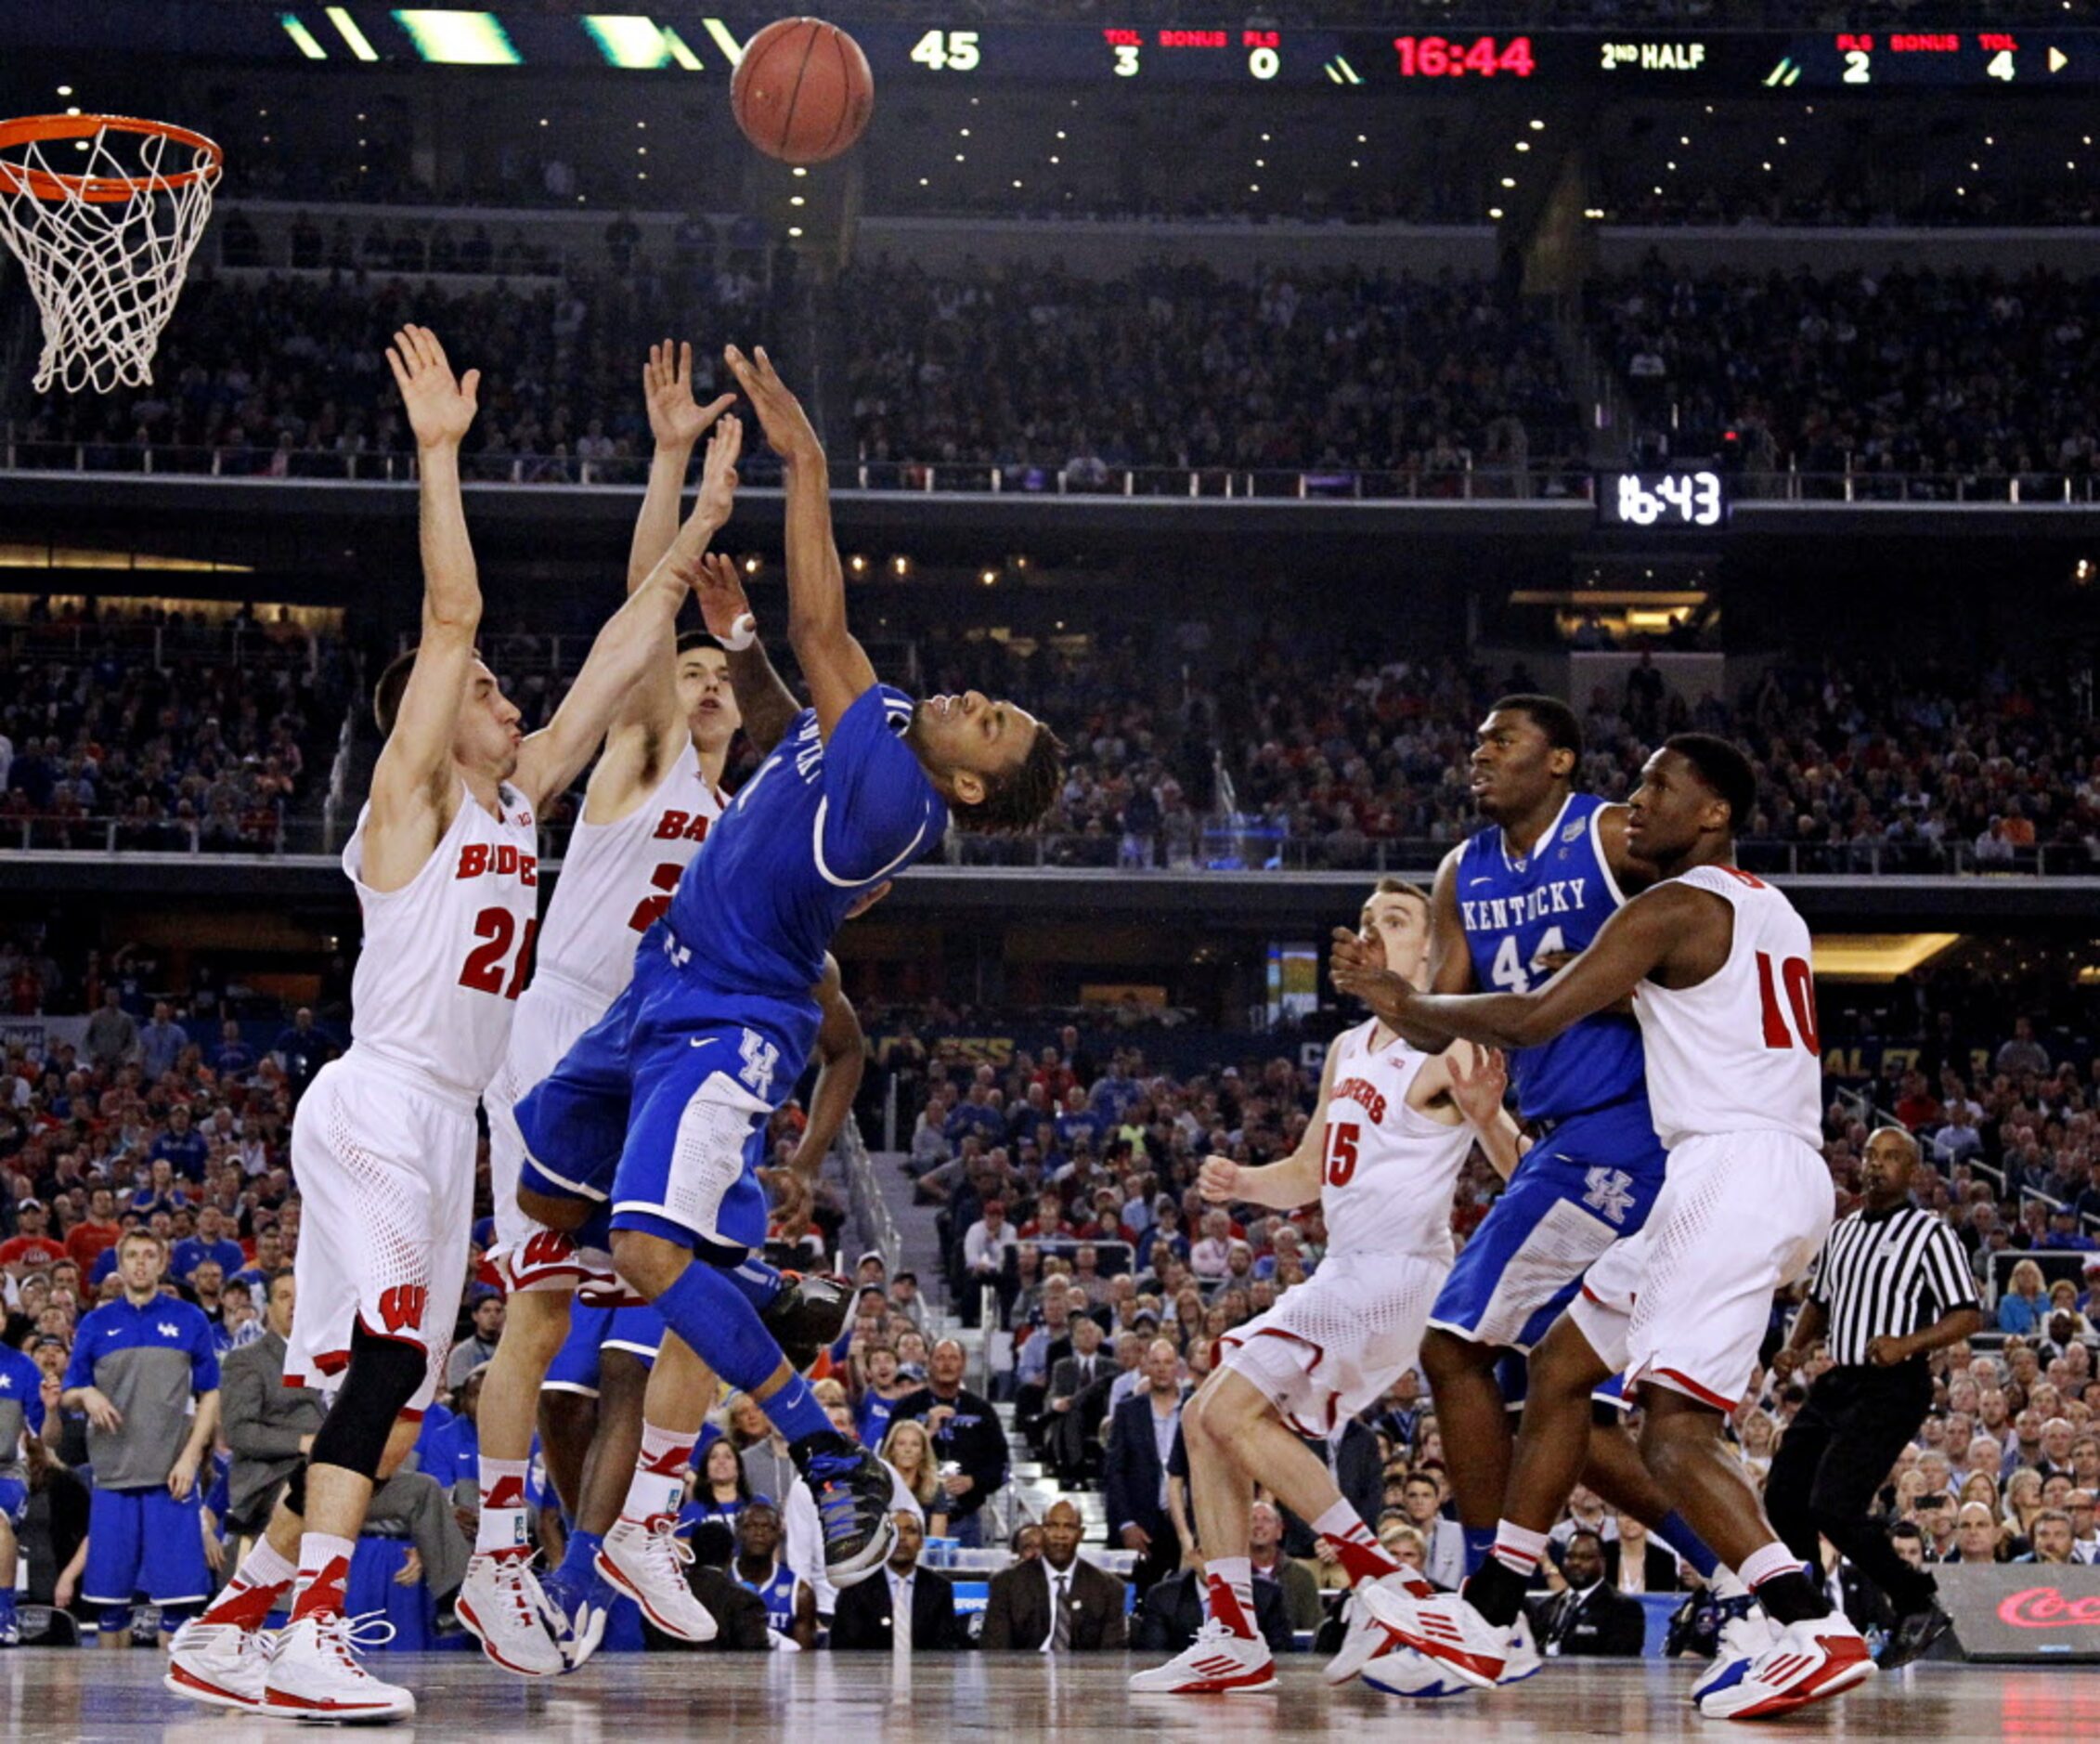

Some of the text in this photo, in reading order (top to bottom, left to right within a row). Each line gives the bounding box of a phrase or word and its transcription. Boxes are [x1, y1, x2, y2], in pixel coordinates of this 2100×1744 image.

[910, 30, 980, 71] 45
[1103, 29, 1143, 46] TOL
[1159, 30, 1227, 46] BONUS
[1242, 31, 1280, 47] FLS
[1836, 33, 1873, 51] FLS
[1890, 33, 1959, 51] BONUS
[1977, 33, 2018, 50] TOL
[1114, 45, 1139, 77] 3
[1249, 47, 1280, 80] 0
[1394, 35, 1535, 77] 16:44
[1601, 43, 1705, 70] 2ND HALF
[1843, 49, 1871, 84] 2
[1987, 49, 2016, 82] 4
[1618, 471, 1720, 526] 16:43
[1462, 878, 1586, 931] KENTUCKY
[1755, 950, 1821, 1057] 10
[1321, 1122, 1360, 1188] 15
[379, 1283, 428, 1334] W
